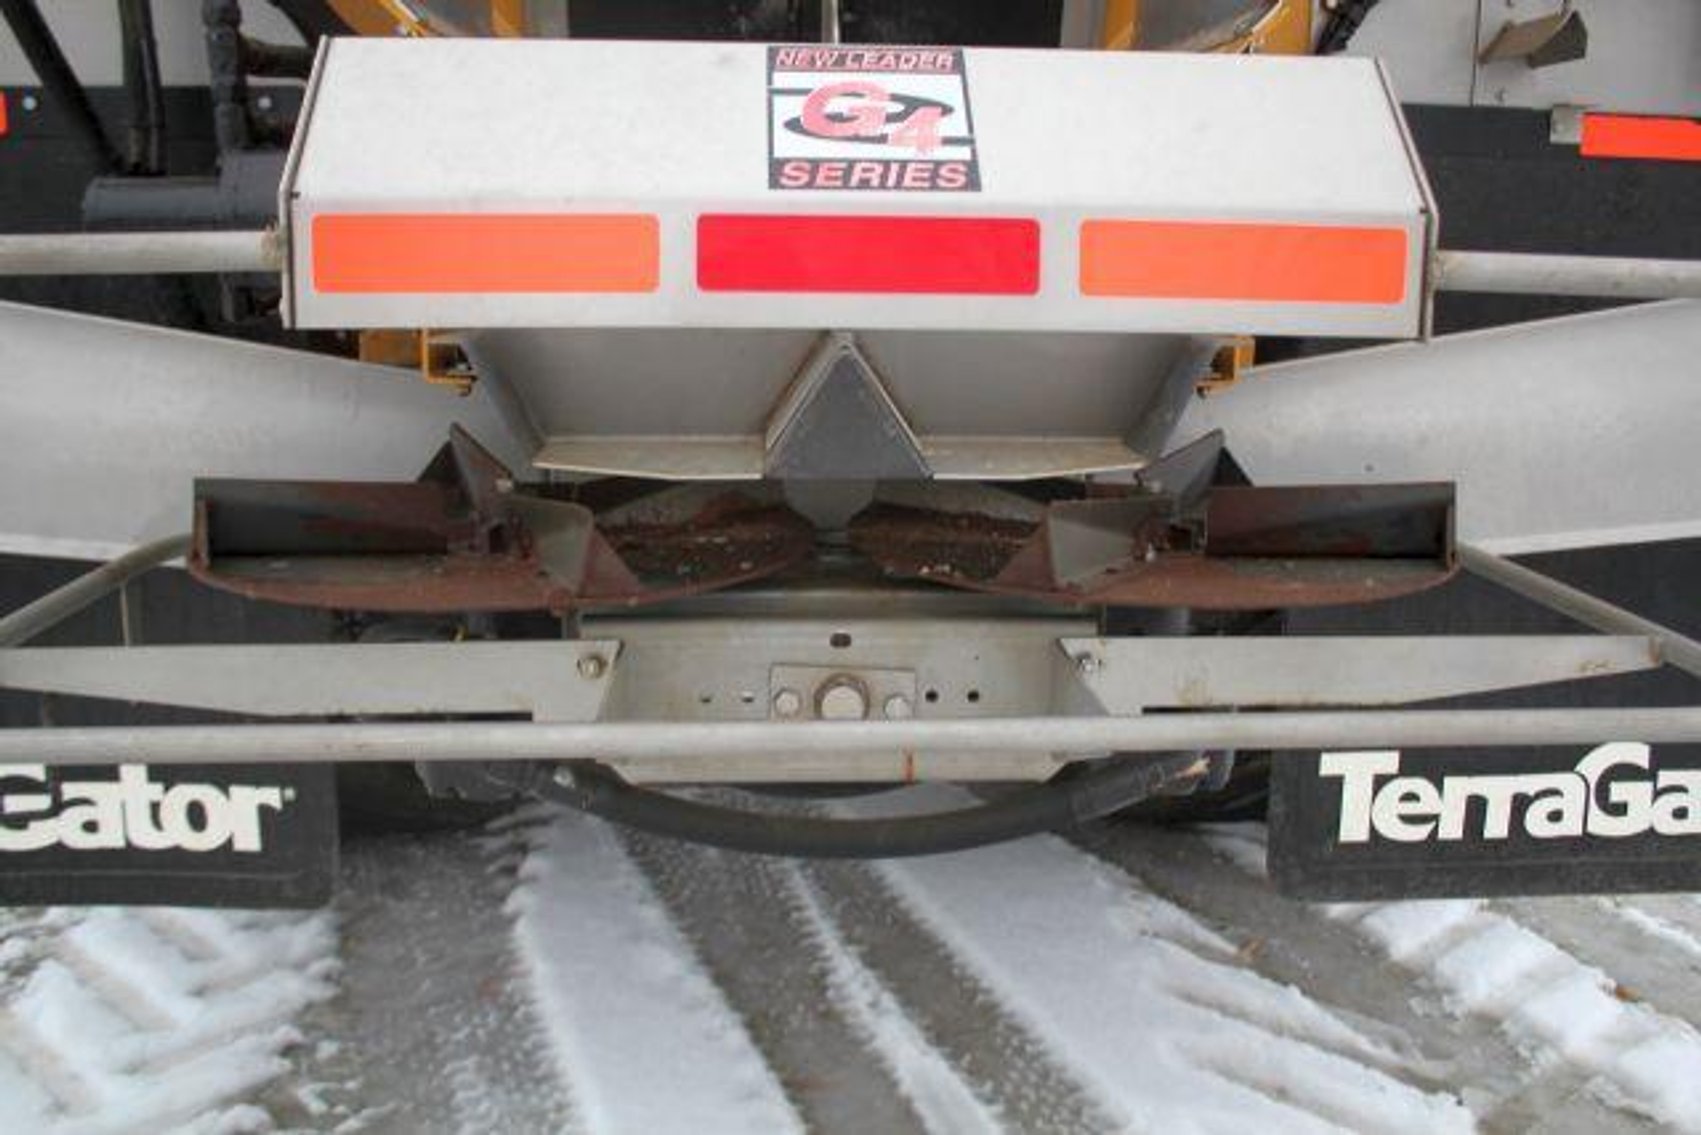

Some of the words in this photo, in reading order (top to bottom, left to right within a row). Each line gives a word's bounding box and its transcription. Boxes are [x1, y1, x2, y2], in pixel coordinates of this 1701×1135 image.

[776, 48, 838, 68] NEW
[846, 50, 953, 71] LEADER
[779, 161, 968, 188] SERIES
